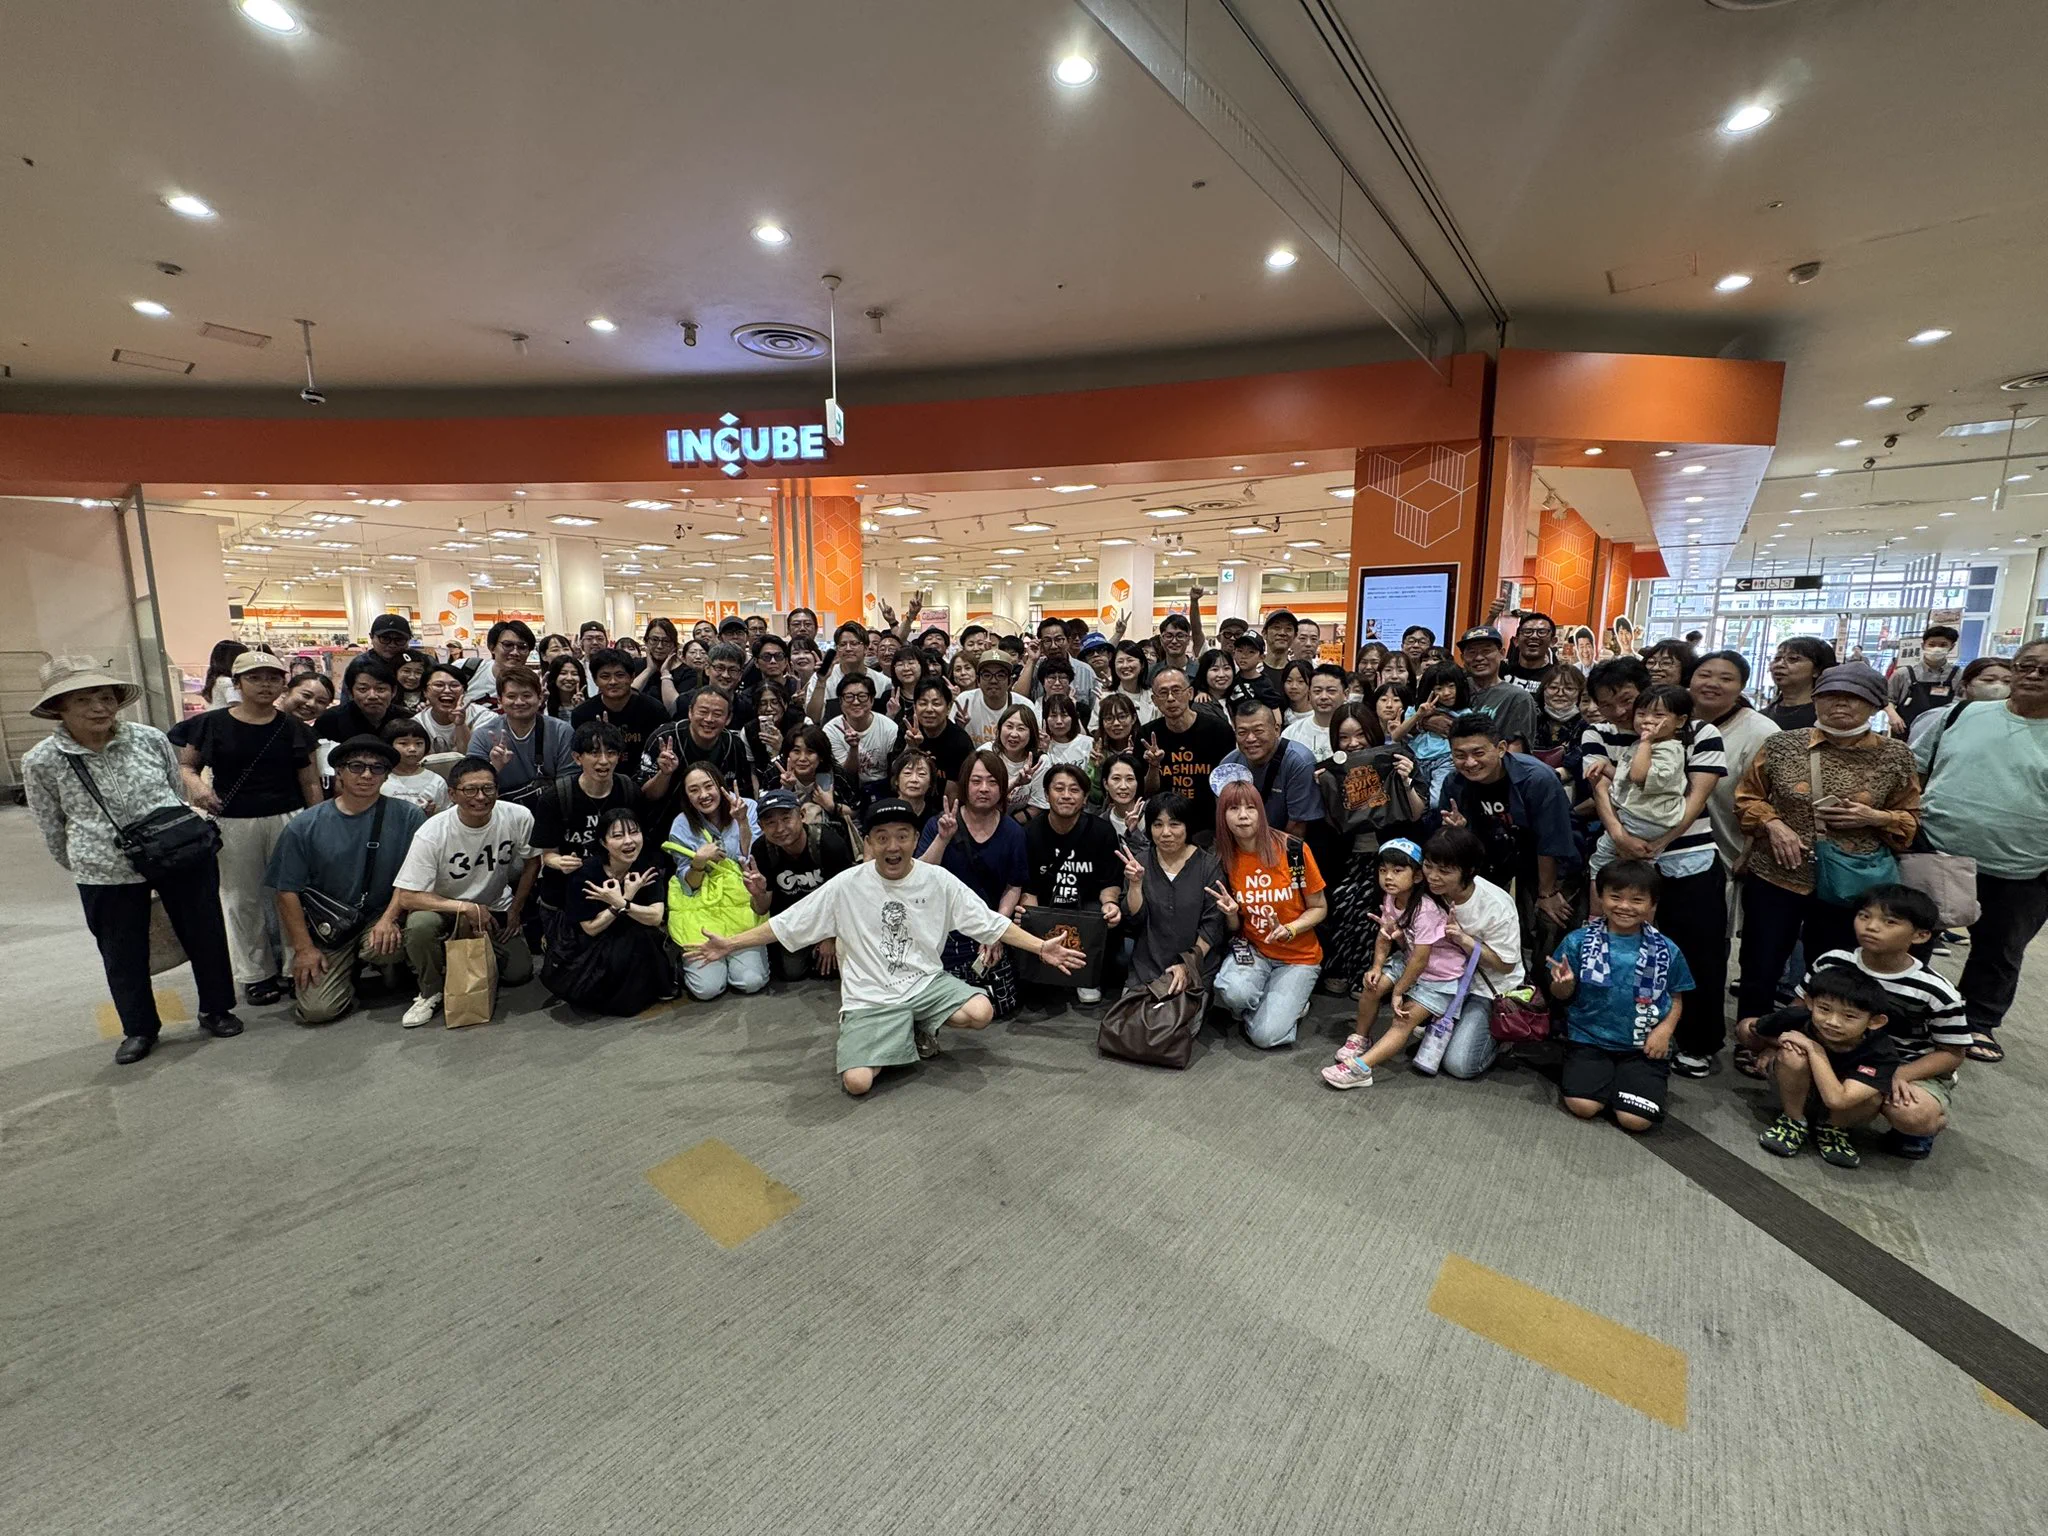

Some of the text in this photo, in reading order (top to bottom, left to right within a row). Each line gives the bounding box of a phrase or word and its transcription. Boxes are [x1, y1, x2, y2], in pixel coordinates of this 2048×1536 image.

[666, 425, 825, 463] INCUBE
[1171, 751, 1194, 763] NO
[1173, 776, 1194, 788] NO
[1481, 800, 1505, 815] NO
[448, 839, 516, 880] 343
[1056, 872, 1077, 886] NO
[1245, 874, 1272, 889] NO
[1236, 886, 1293, 904] ASHIMI
[1246, 904, 1275, 918] NO
